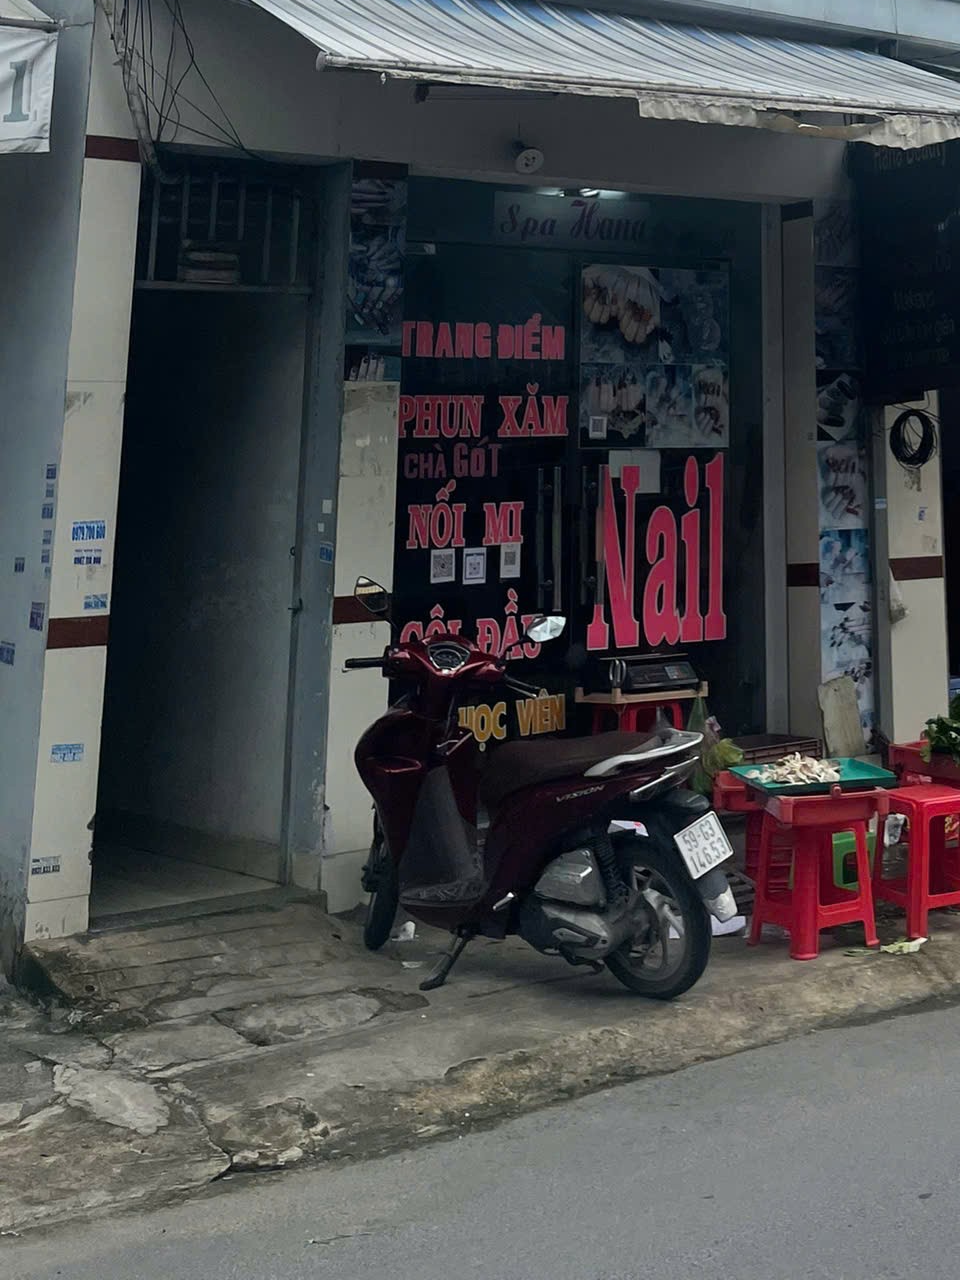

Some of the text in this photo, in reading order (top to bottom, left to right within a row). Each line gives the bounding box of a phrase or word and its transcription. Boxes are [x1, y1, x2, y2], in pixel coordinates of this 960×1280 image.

[500, 203, 557, 242] Spa
[401, 313, 566, 360] TRANG ĐIỂM
[398, 381, 570, 439] PHUN XĂM
[403, 443, 447, 480] CHÀ
[406, 478, 525, 550] NỐI MI
[586, 451, 728, 651] Nail
[515, 687, 567, 738] VIÊN
[555, 784, 606, 803] VISION
[682, 819, 715, 852] 59-G3
[689, 836, 727, 874] 146.53
